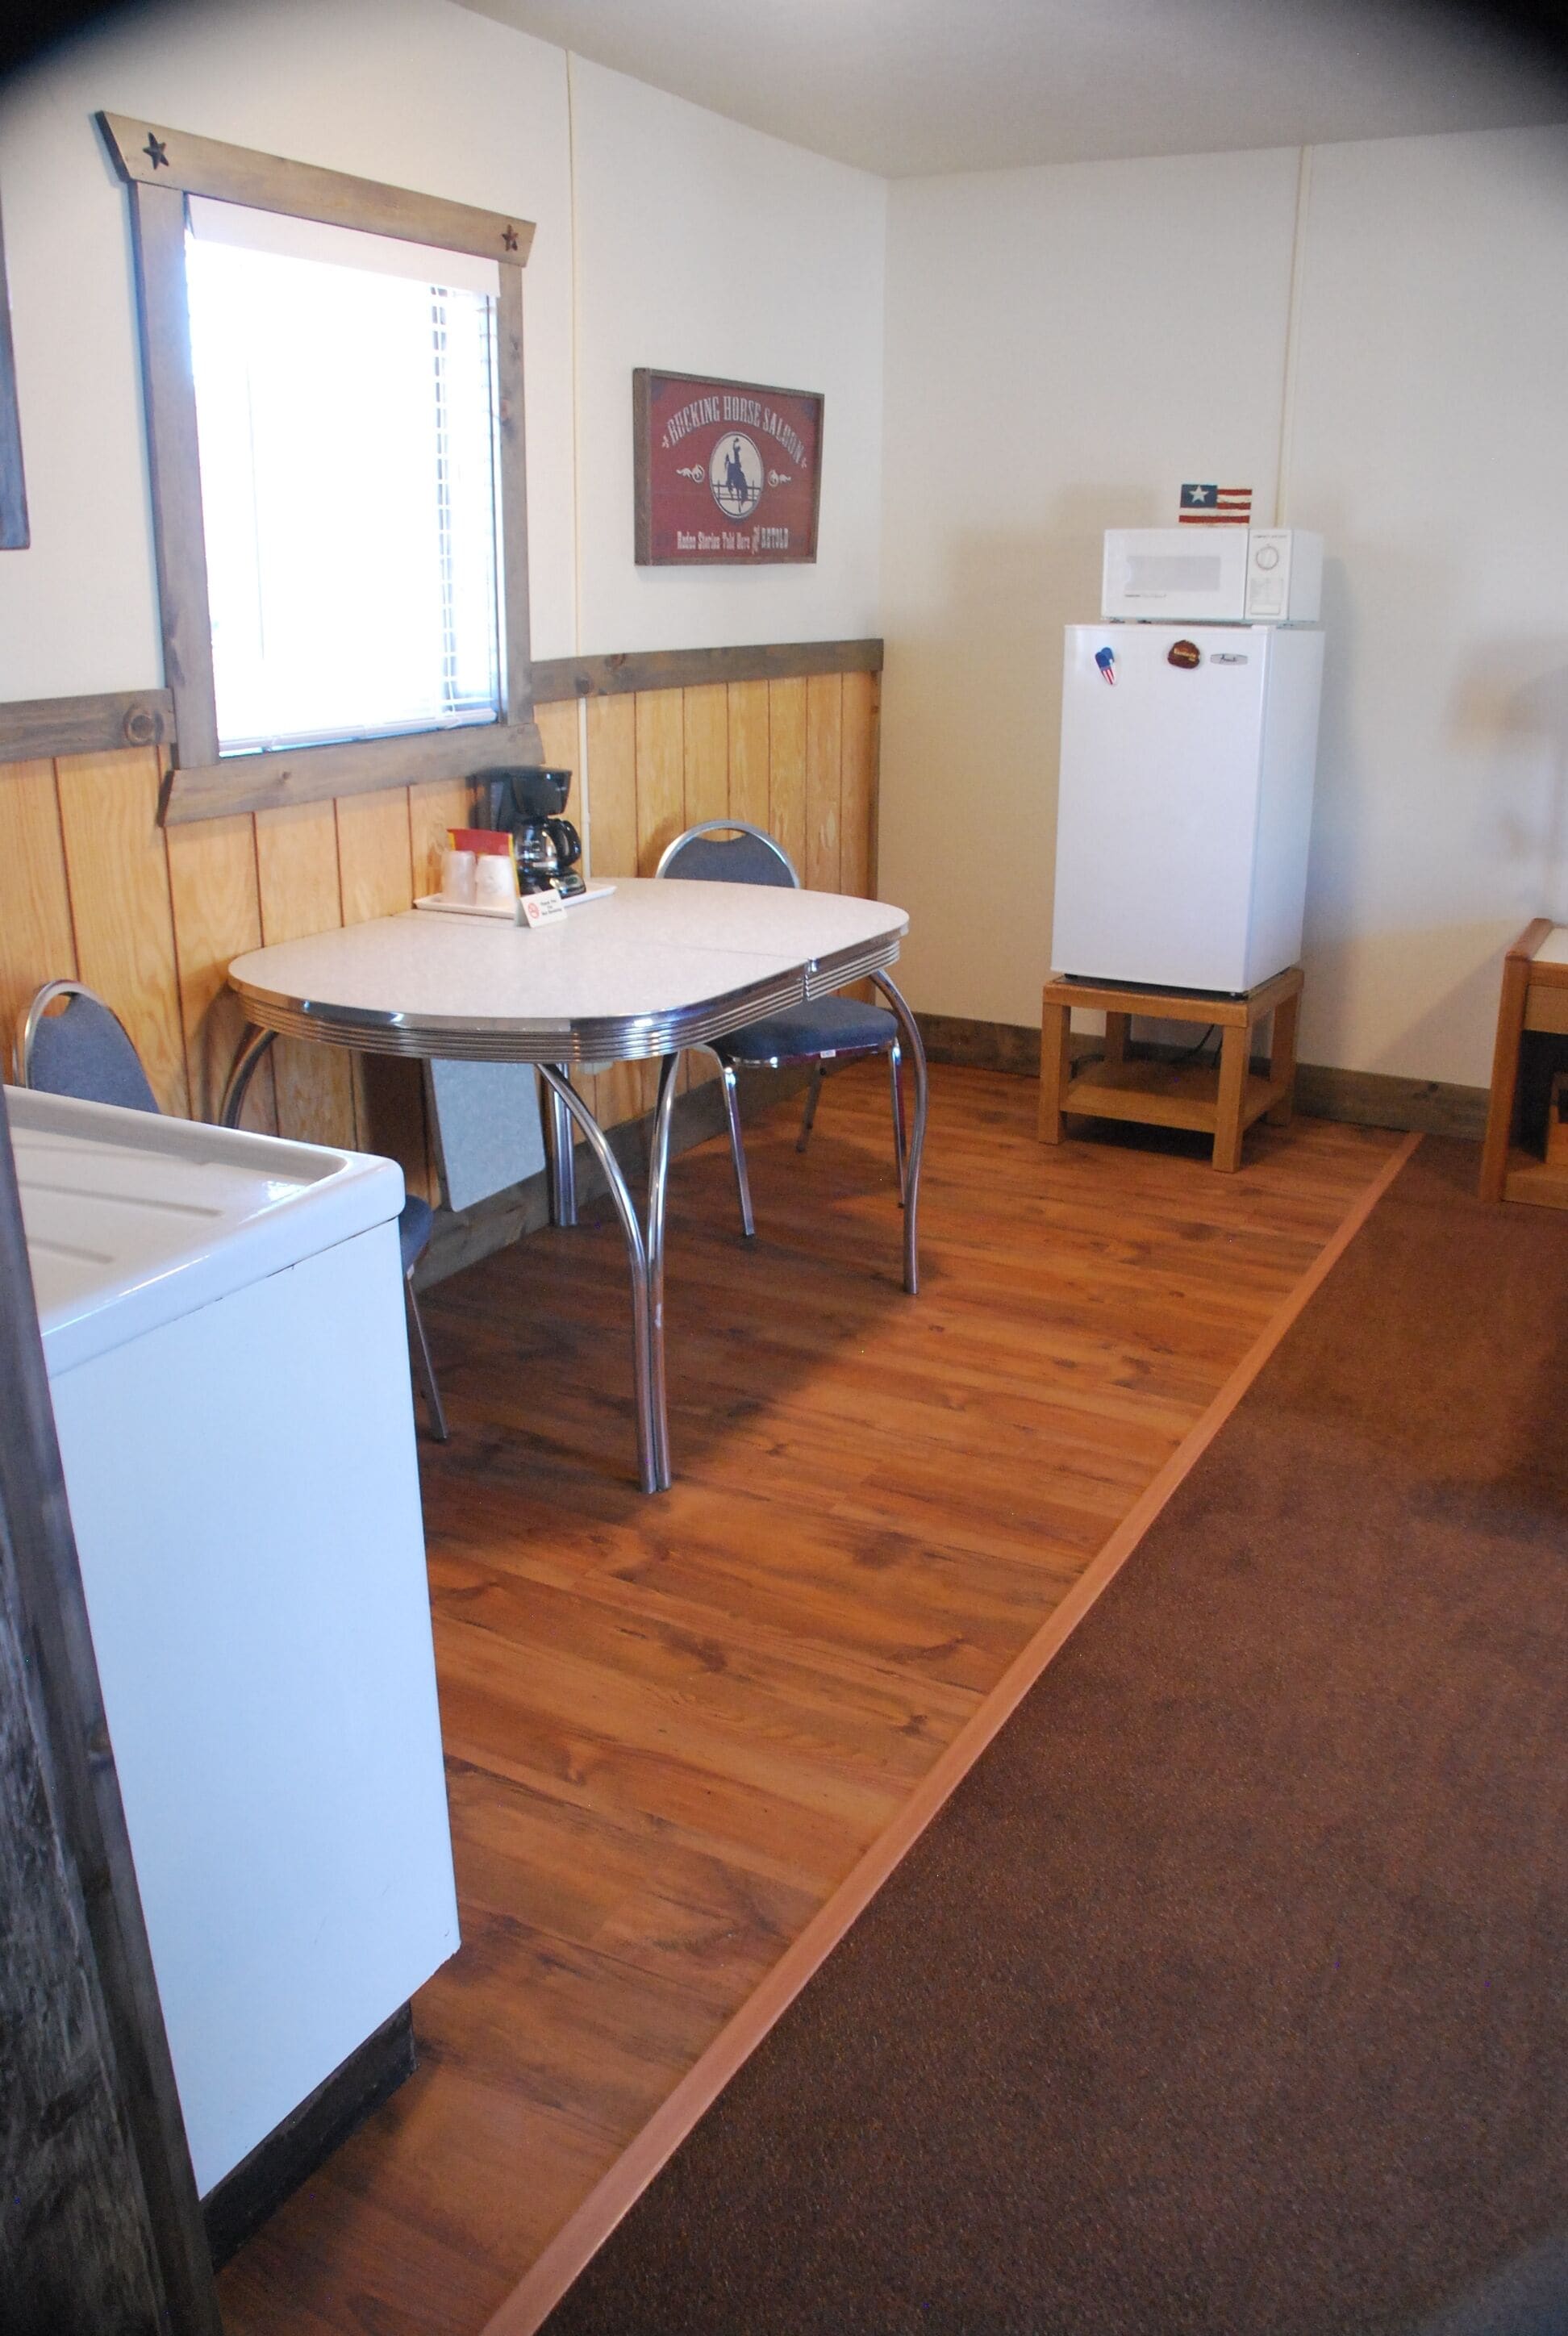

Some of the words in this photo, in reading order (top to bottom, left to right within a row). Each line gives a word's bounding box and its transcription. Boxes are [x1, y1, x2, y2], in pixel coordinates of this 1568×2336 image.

[667, 396, 720, 445] BUCKING
[724, 396, 761, 428] HORSE
[762, 407, 804, 464] SALOON
